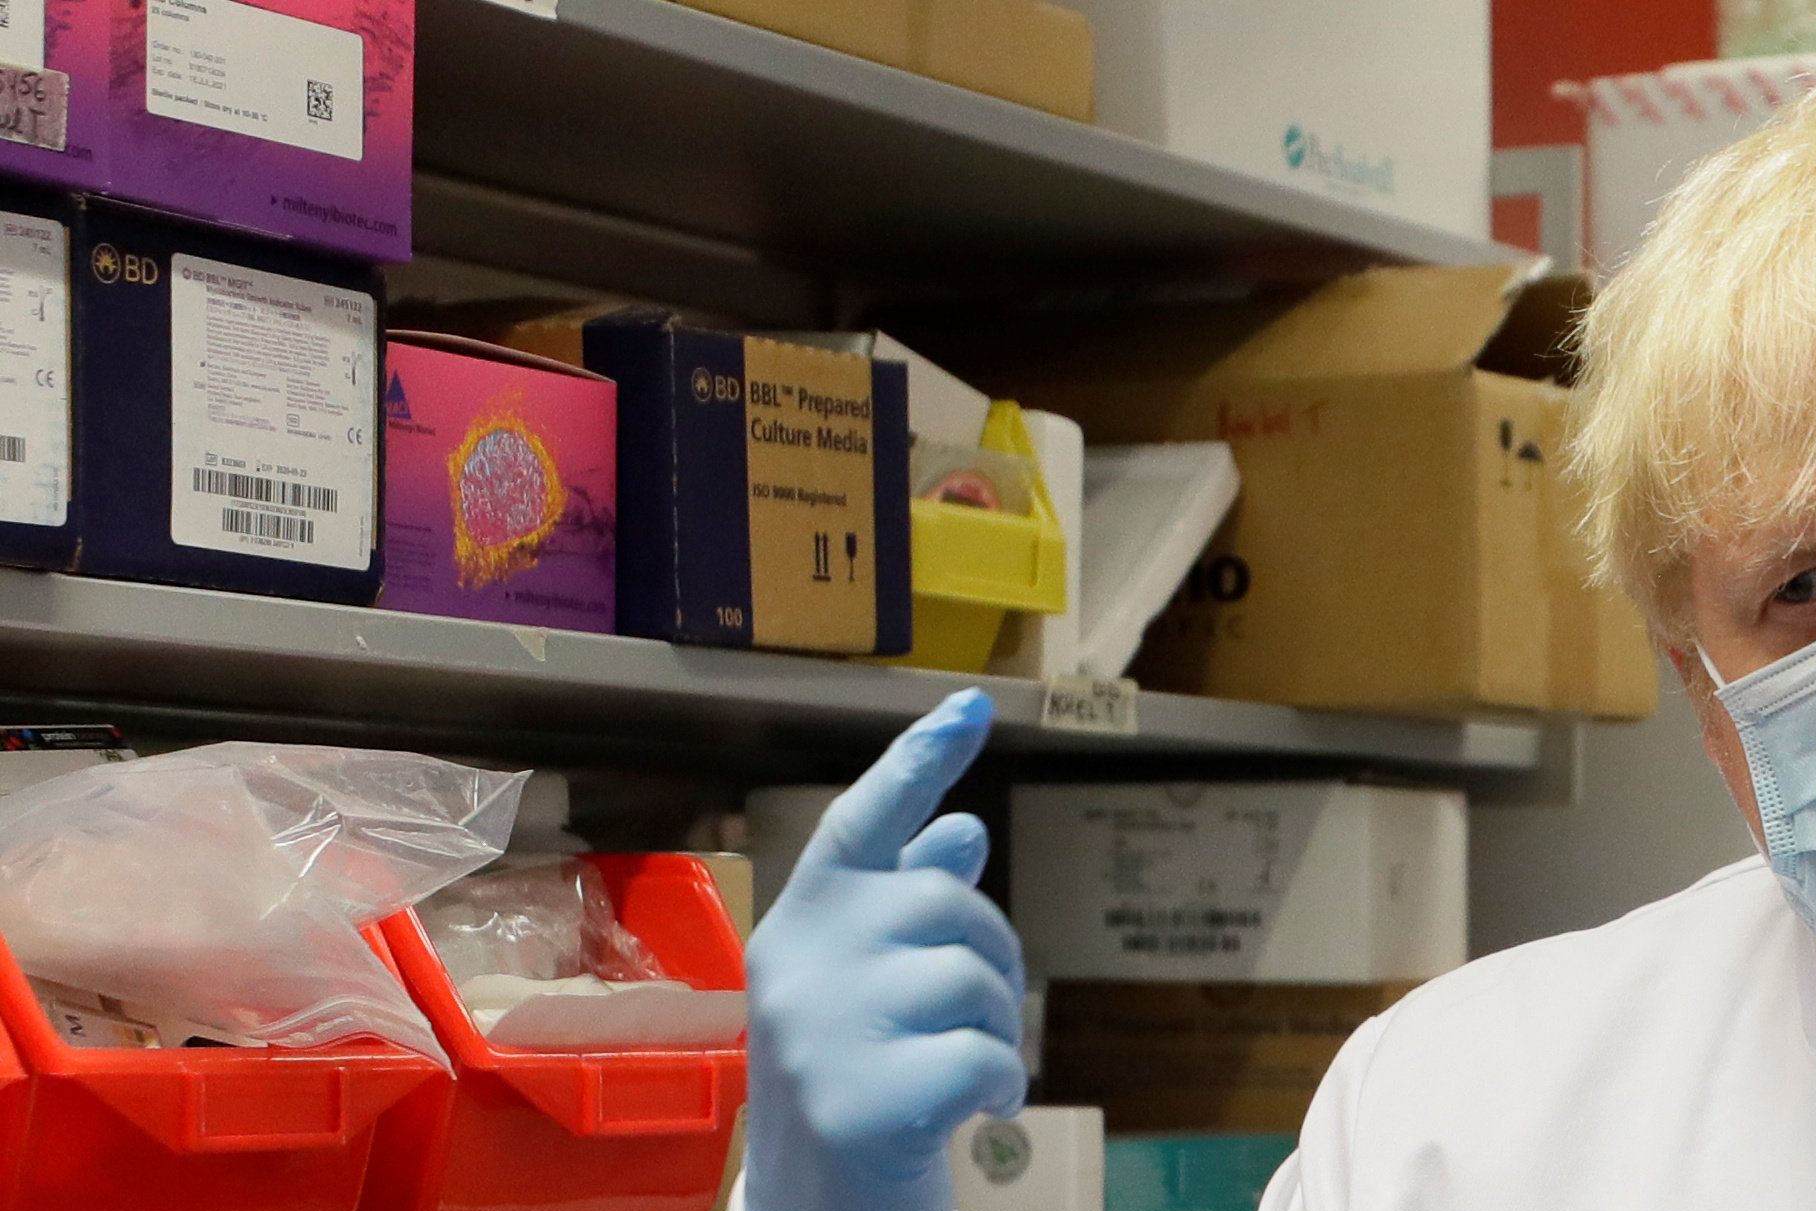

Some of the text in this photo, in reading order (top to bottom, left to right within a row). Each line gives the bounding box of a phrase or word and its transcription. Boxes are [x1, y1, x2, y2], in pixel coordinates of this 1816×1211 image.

[125, 254, 158, 285] BD
[713, 375, 740, 401] BD
[798, 387, 870, 421] Prepared
[751, 416, 869, 455] Culture Media
[753, 484, 770, 498] ISO
[717, 606, 743, 629] 100
